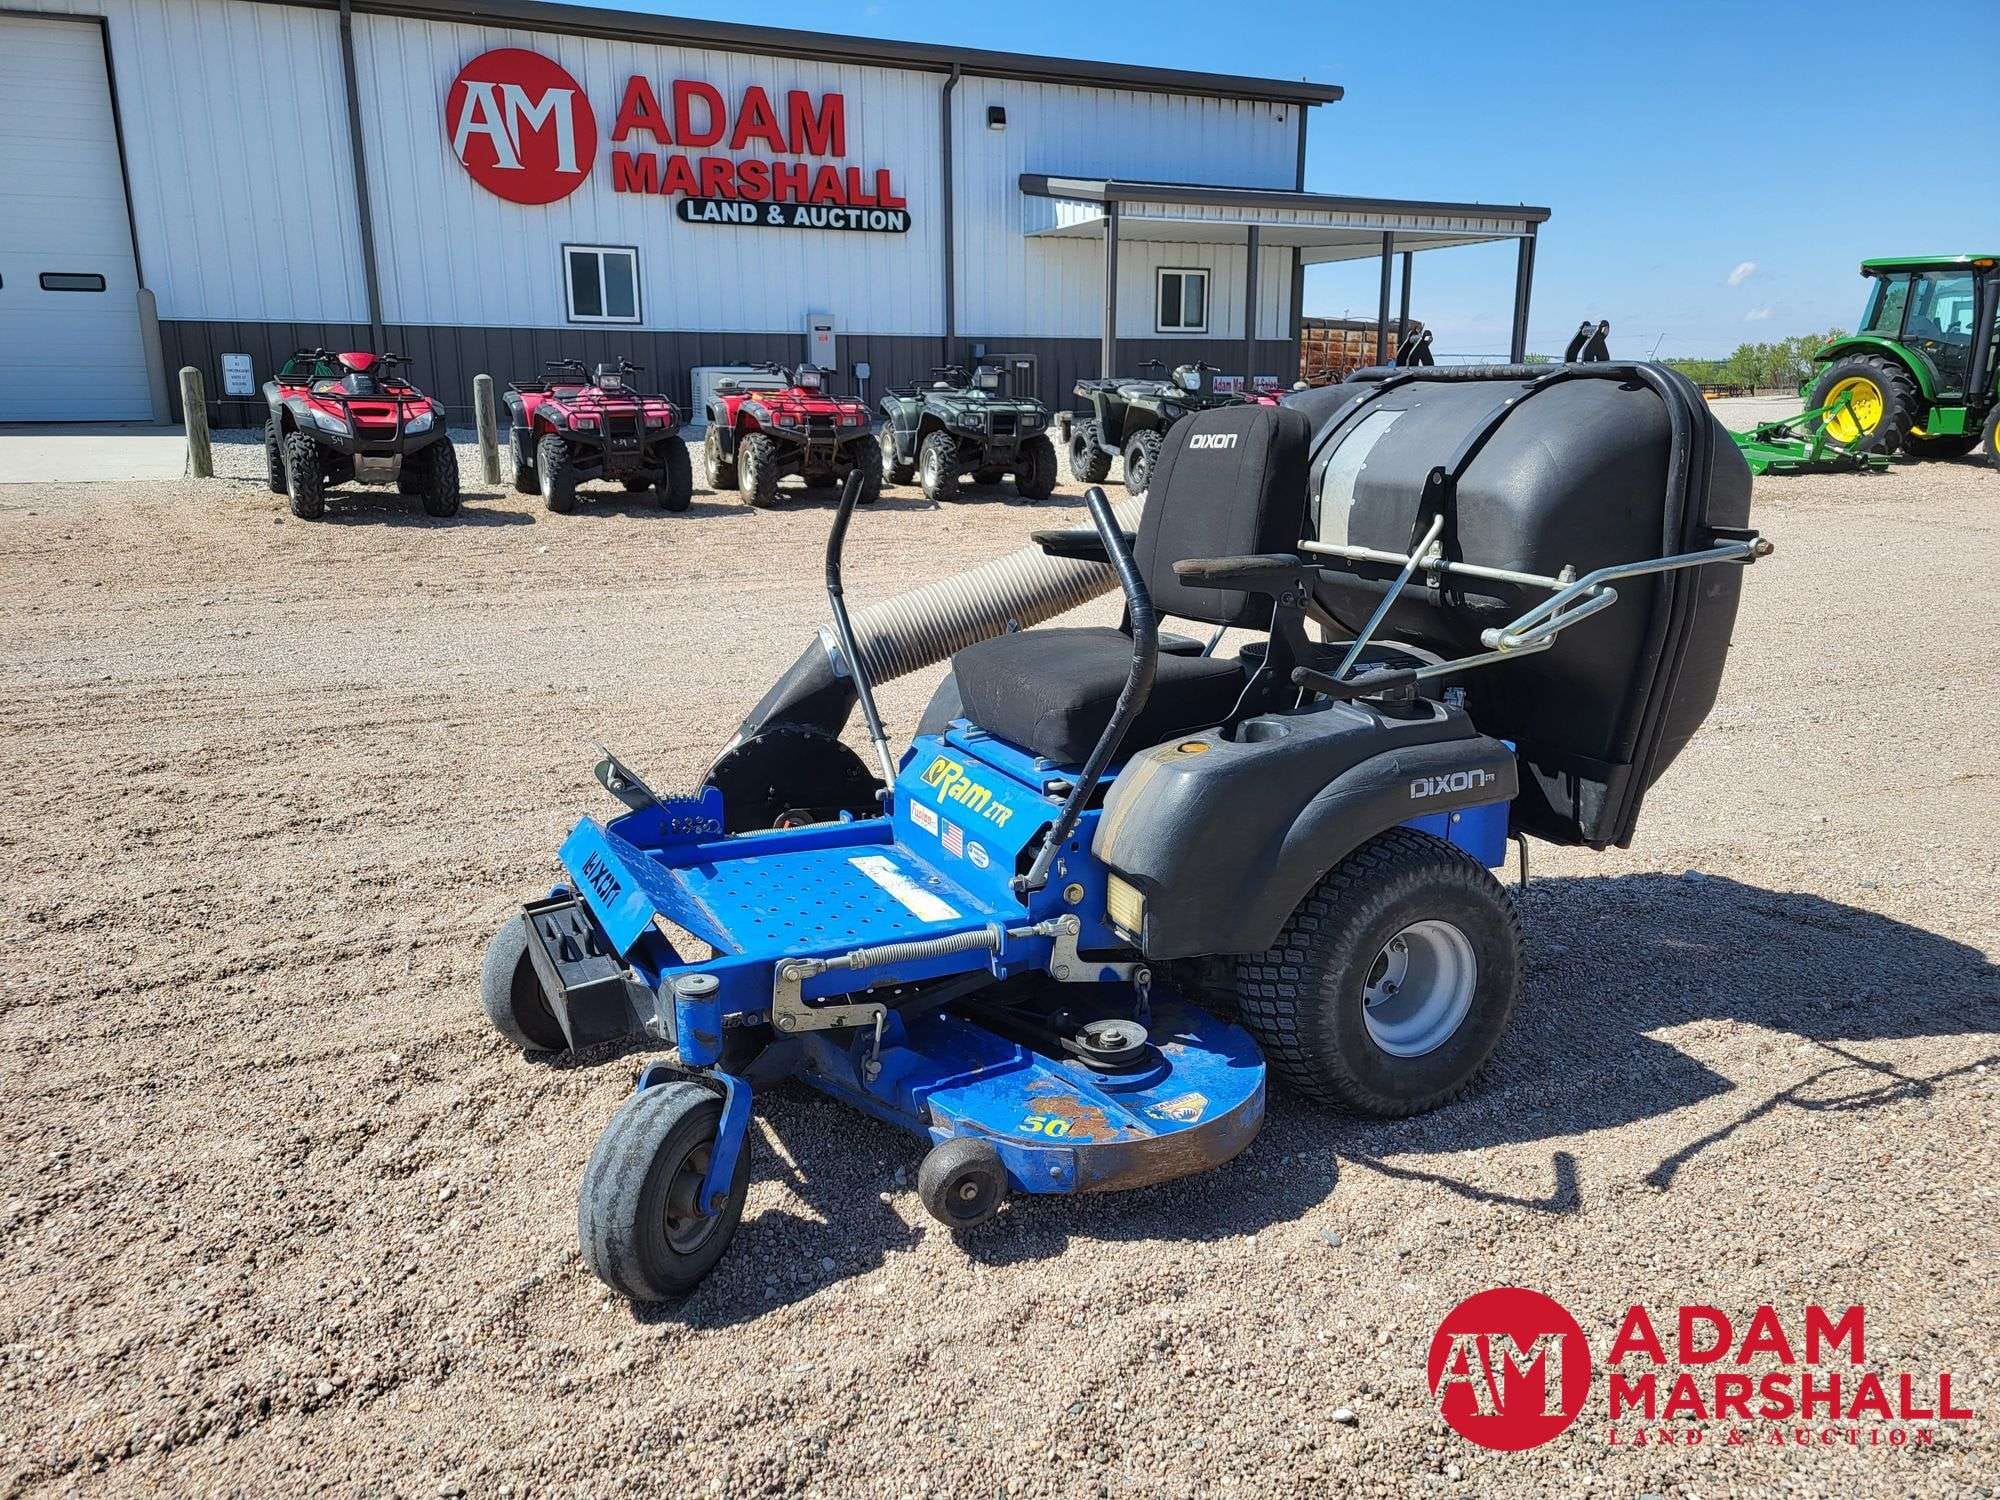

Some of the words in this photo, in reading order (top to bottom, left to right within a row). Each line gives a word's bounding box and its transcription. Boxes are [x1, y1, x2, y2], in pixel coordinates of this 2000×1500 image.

[452, 80, 583, 174] AM
[611, 75, 846, 157] ADAM
[612, 151, 907, 208] MARSHALL
[686, 200, 758, 224] LAND
[766, 205, 786, 226] &
[793, 206, 905, 231] AUCTION
[1189, 434, 1238, 449] DIXON
[934, 760, 992, 812] Ram
[1410, 769, 1485, 799] DIXON
[1020, 1115, 1071, 1138] 50
